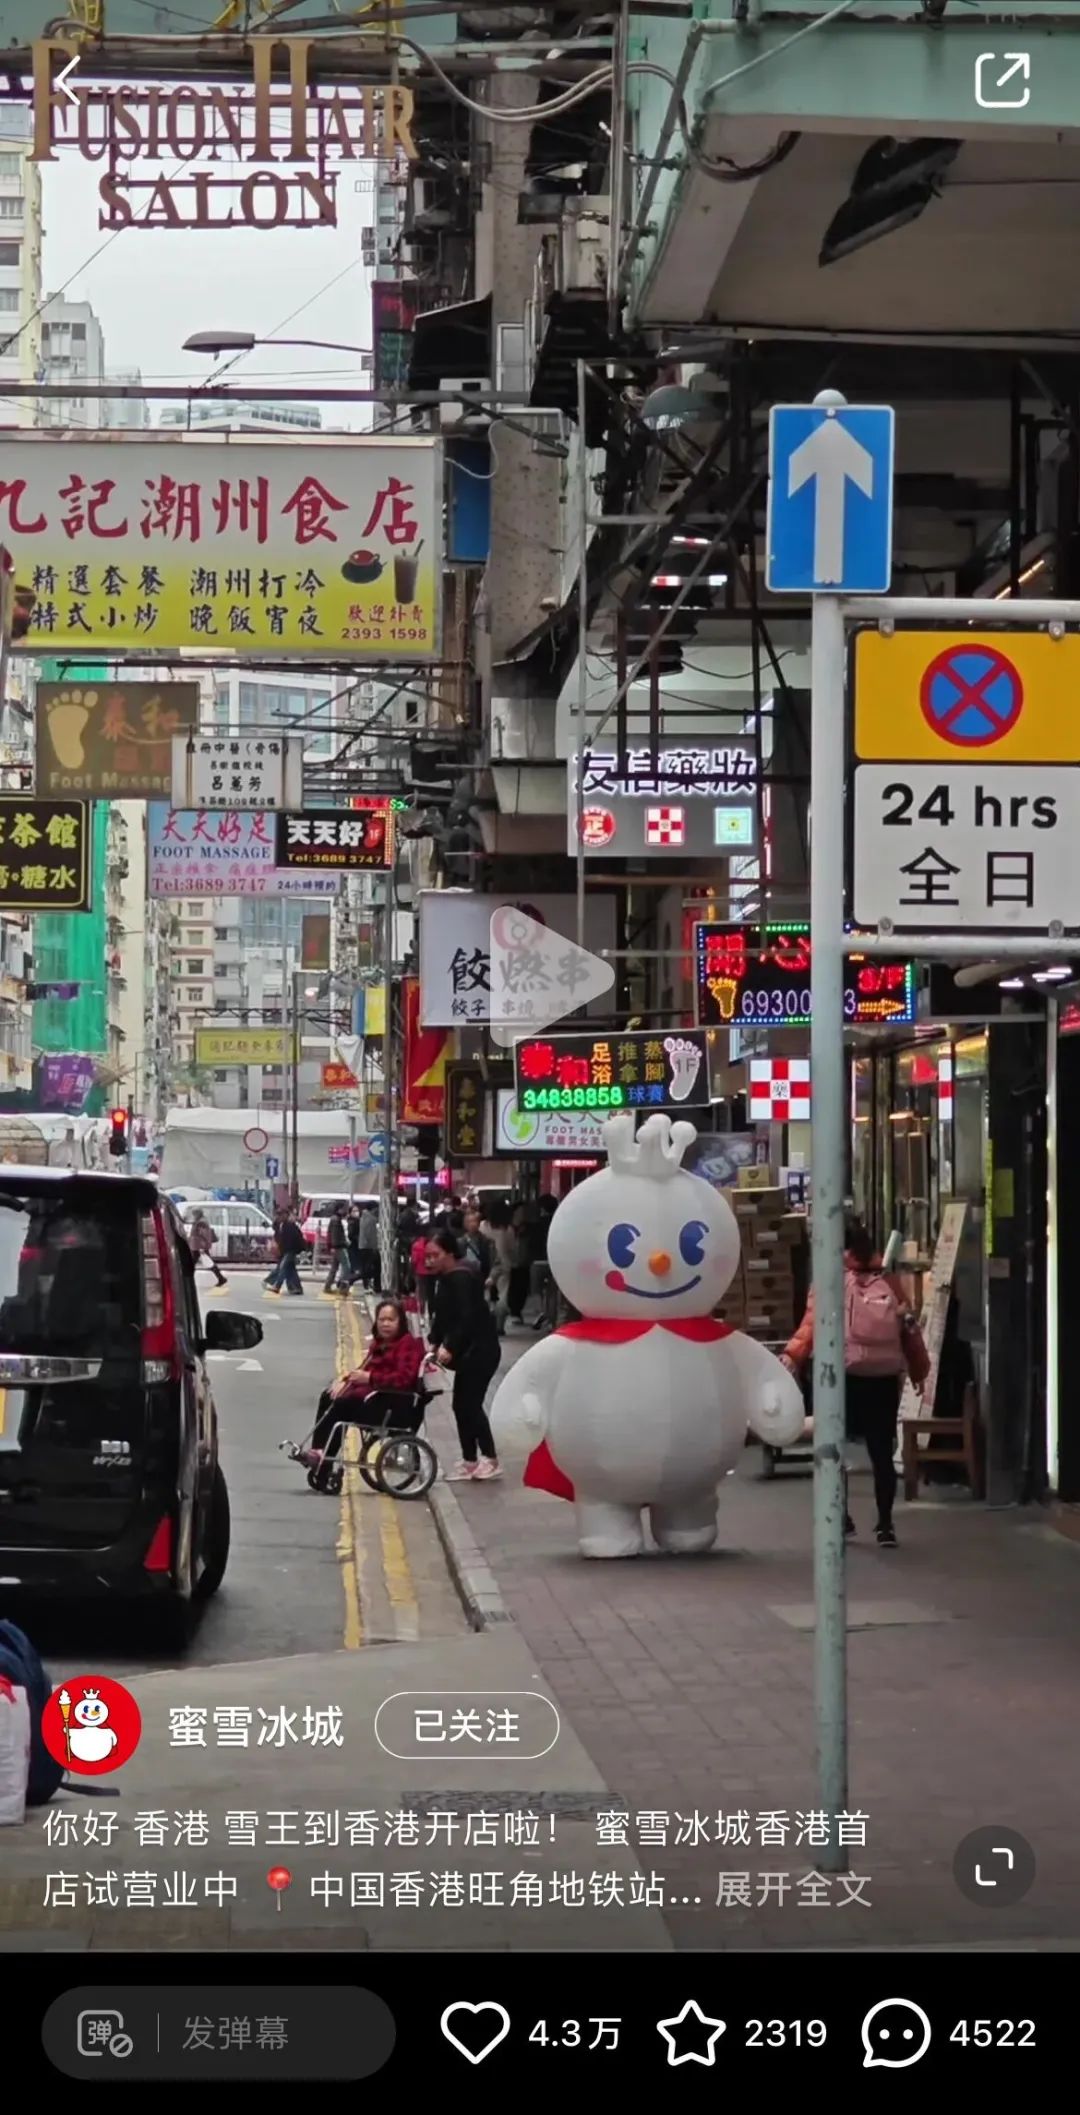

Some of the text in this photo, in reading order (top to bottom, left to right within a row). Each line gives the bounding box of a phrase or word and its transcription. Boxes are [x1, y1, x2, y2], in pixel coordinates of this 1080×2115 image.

[98, 170, 340, 230] SALON
[189, 567, 326, 600] 潮州打冷
[341, 628, 427, 641] 2393 1598
[50, 772, 171, 793] Foot Massag
[881, 783, 1059, 829] 24 hrs
[0, 813, 79, 848] 茶館
[287, 820, 364, 847] 天天好
[153, 846, 271, 858] FOOT MASSAGE
[287, 853, 382, 864] Tel:3689 3747
[152, 878, 267, 891] Tel:3689 3747
[899, 846, 1036, 909] 全日
[450, 998, 487, 1017] 餃子
[522, 1086, 623, 1109] 34838858
[580, 1127, 602, 1136] MAS
